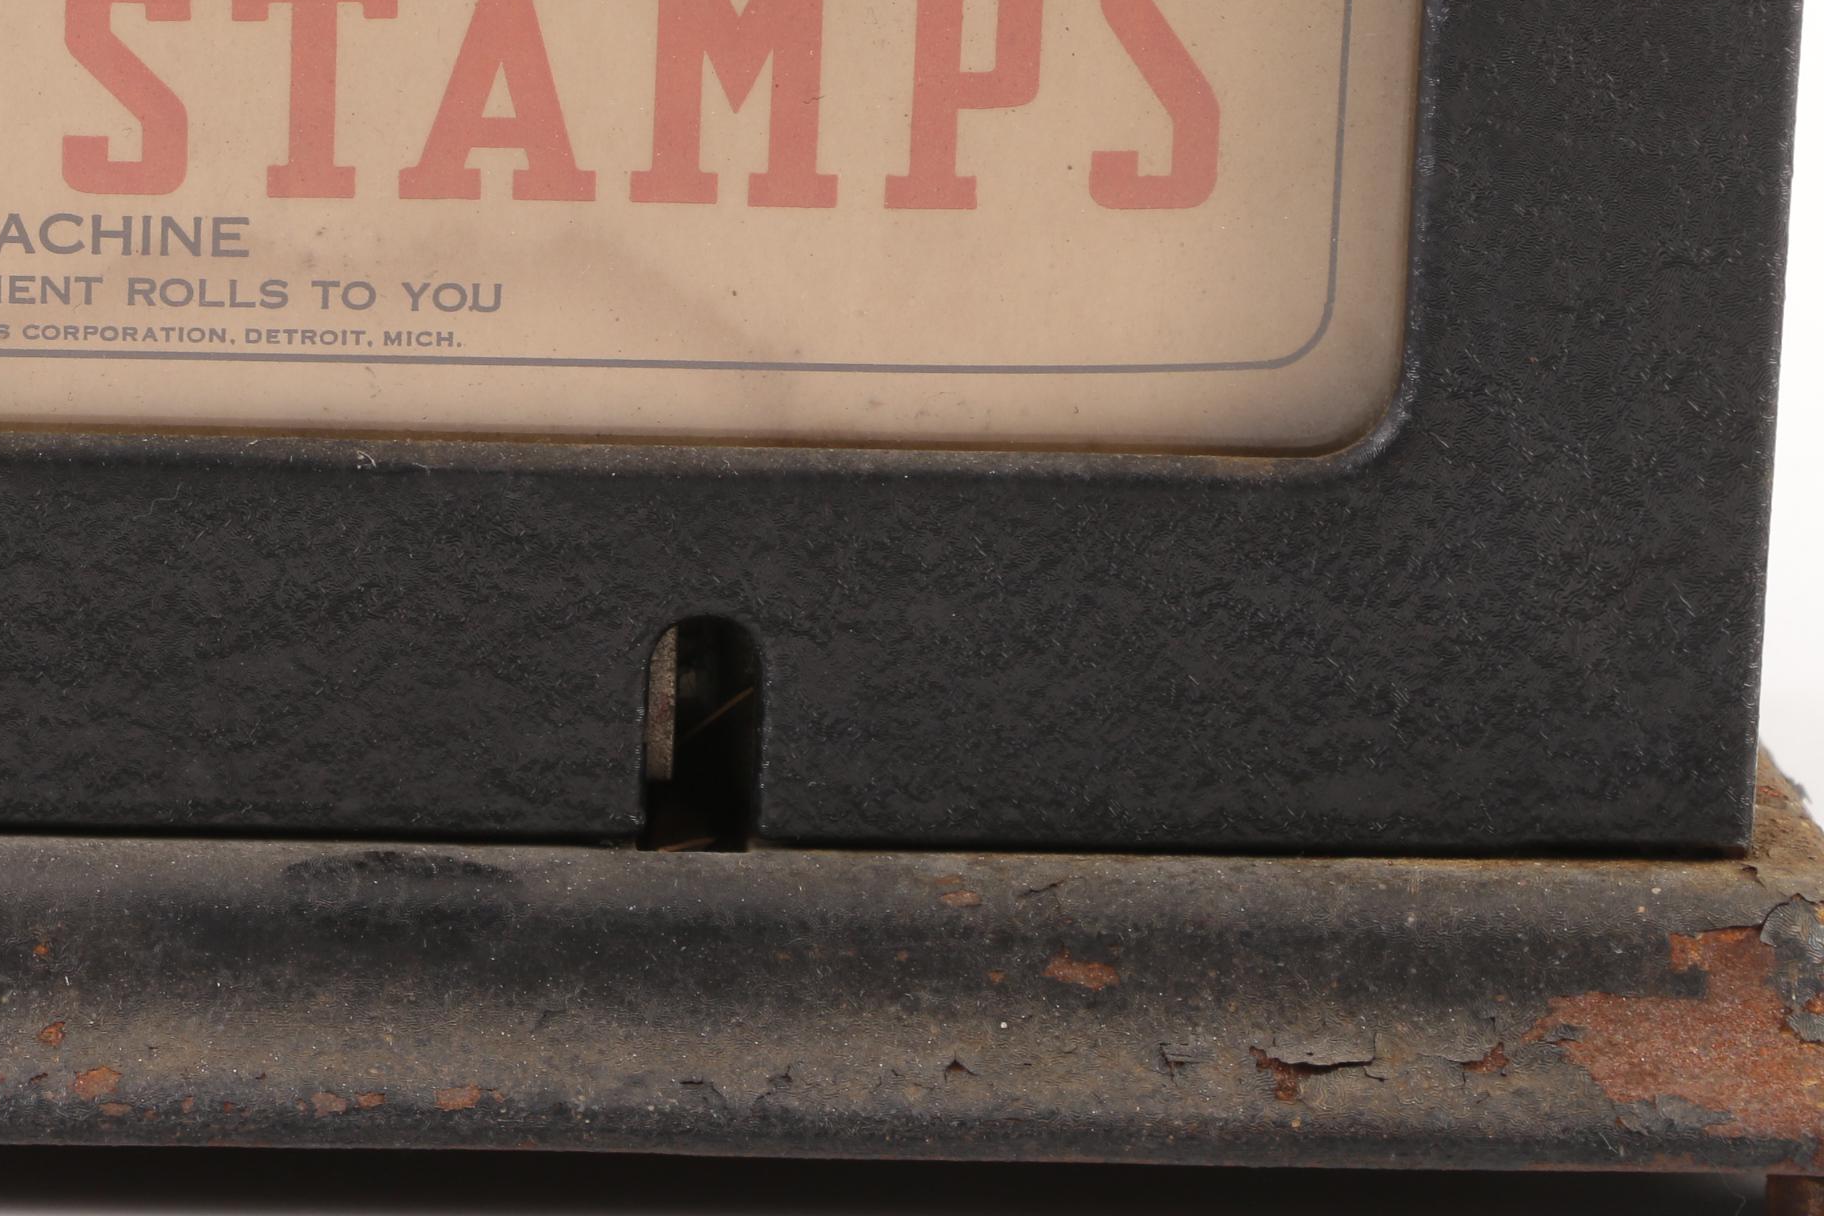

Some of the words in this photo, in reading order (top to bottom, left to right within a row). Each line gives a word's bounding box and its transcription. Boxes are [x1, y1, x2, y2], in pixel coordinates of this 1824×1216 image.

[126, 277, 290, 310] ROLLS
[310, 280, 377, 311] TO
[401, 281, 504, 314] YOU
[21, 324, 237, 346] CORPORATION,
[243, 328, 375, 349] DETROIT,
[382, 330, 464, 348] MICH.
